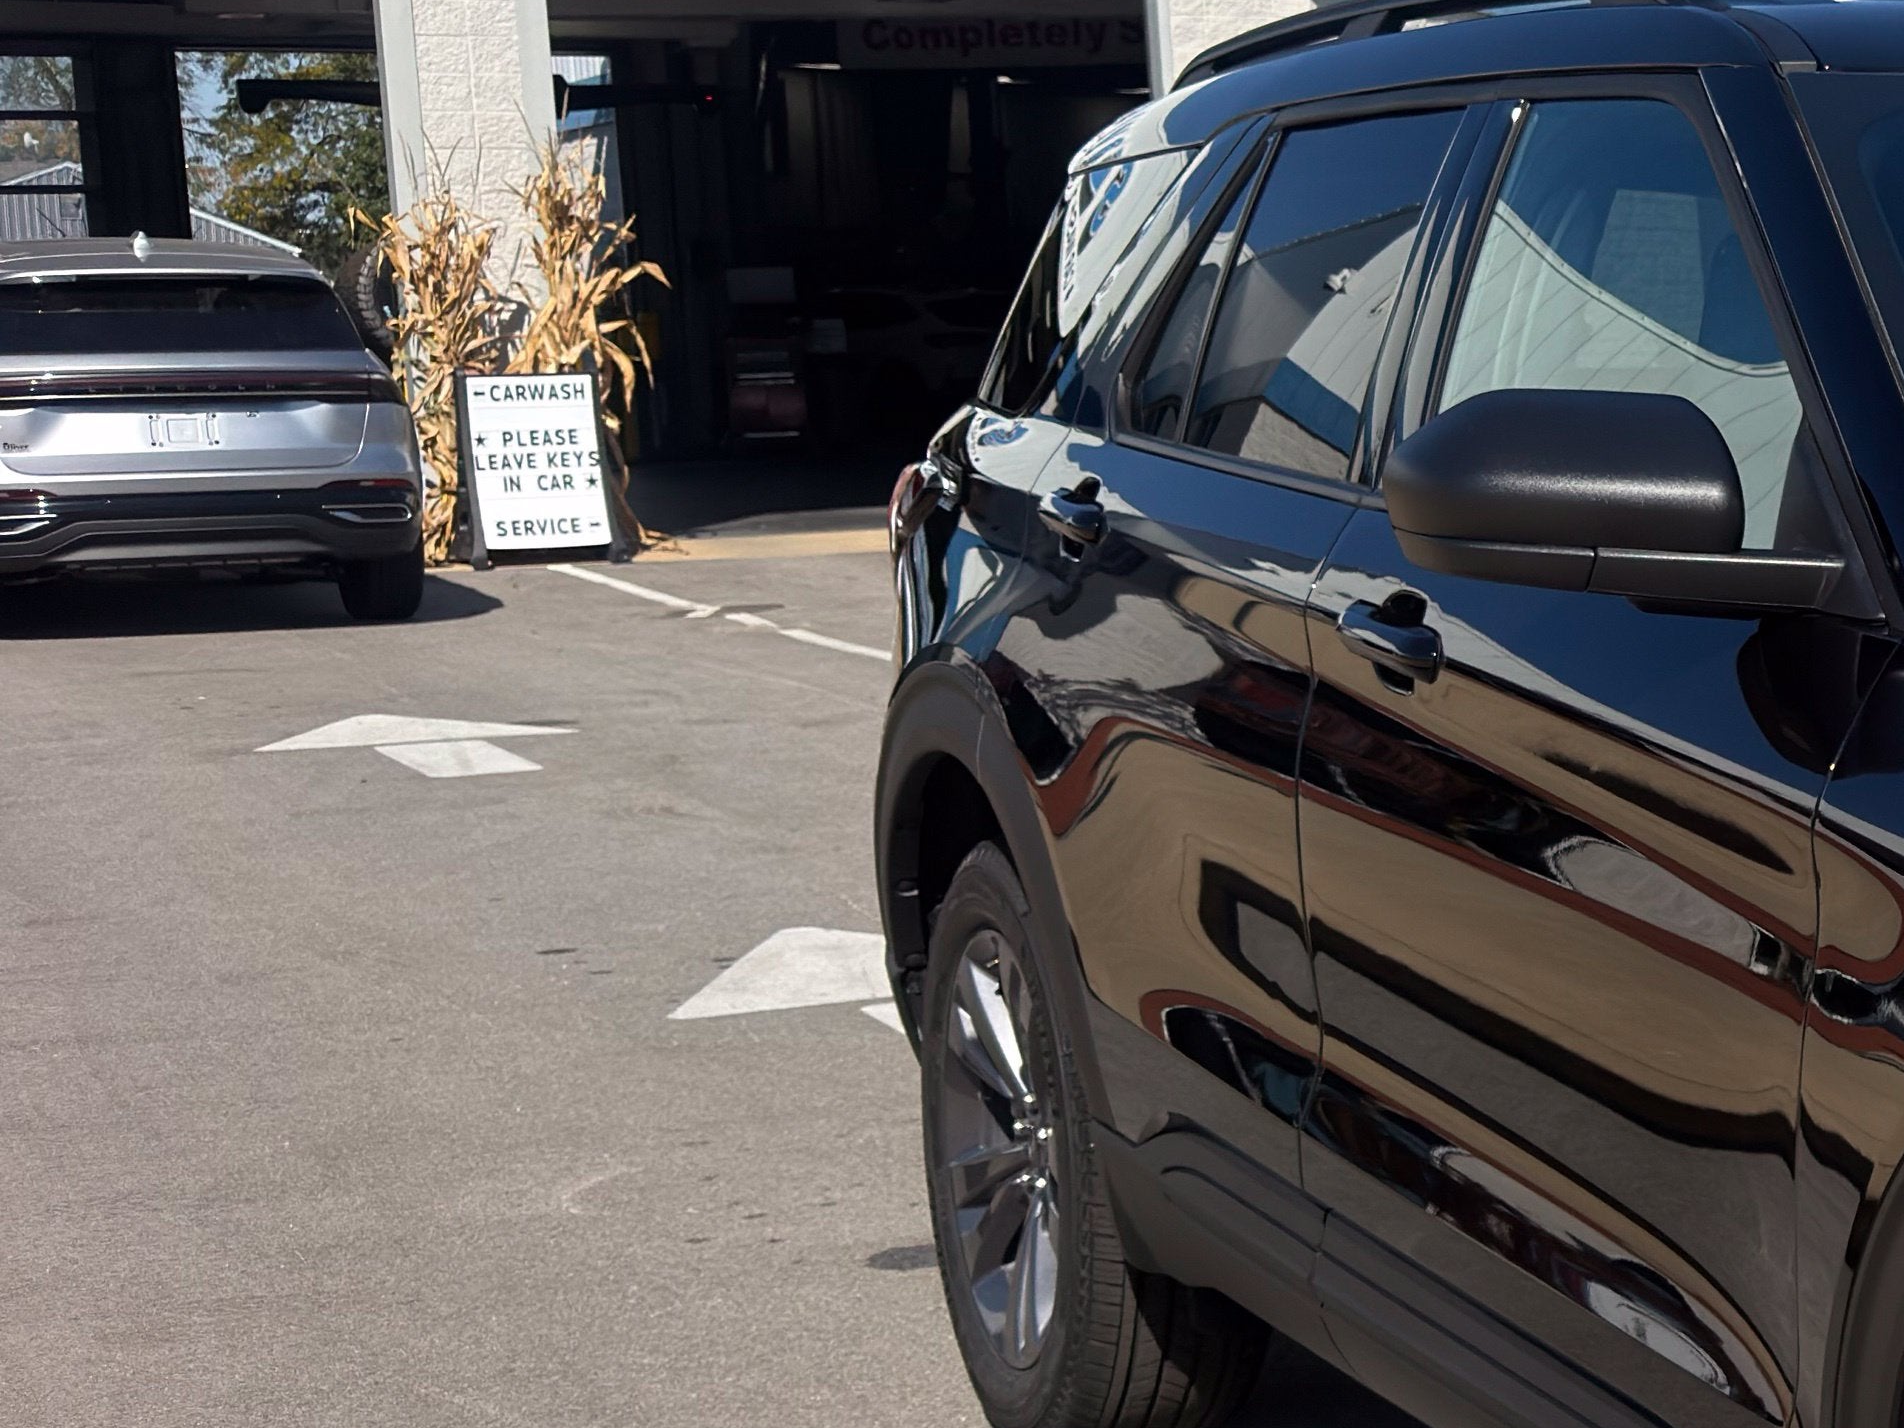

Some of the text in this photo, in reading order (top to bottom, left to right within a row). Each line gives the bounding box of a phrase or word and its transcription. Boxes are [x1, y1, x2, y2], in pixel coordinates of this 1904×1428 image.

[861, 17, 1108, 56] Completely
[490, 383, 585, 402] CARWASH
[502, 429, 579, 447] PLEASE
[475, 451, 600, 471] LEAVE KEYS
[503, 474, 575, 493] IN CAR
[496, 518, 582, 537] SERVICE
